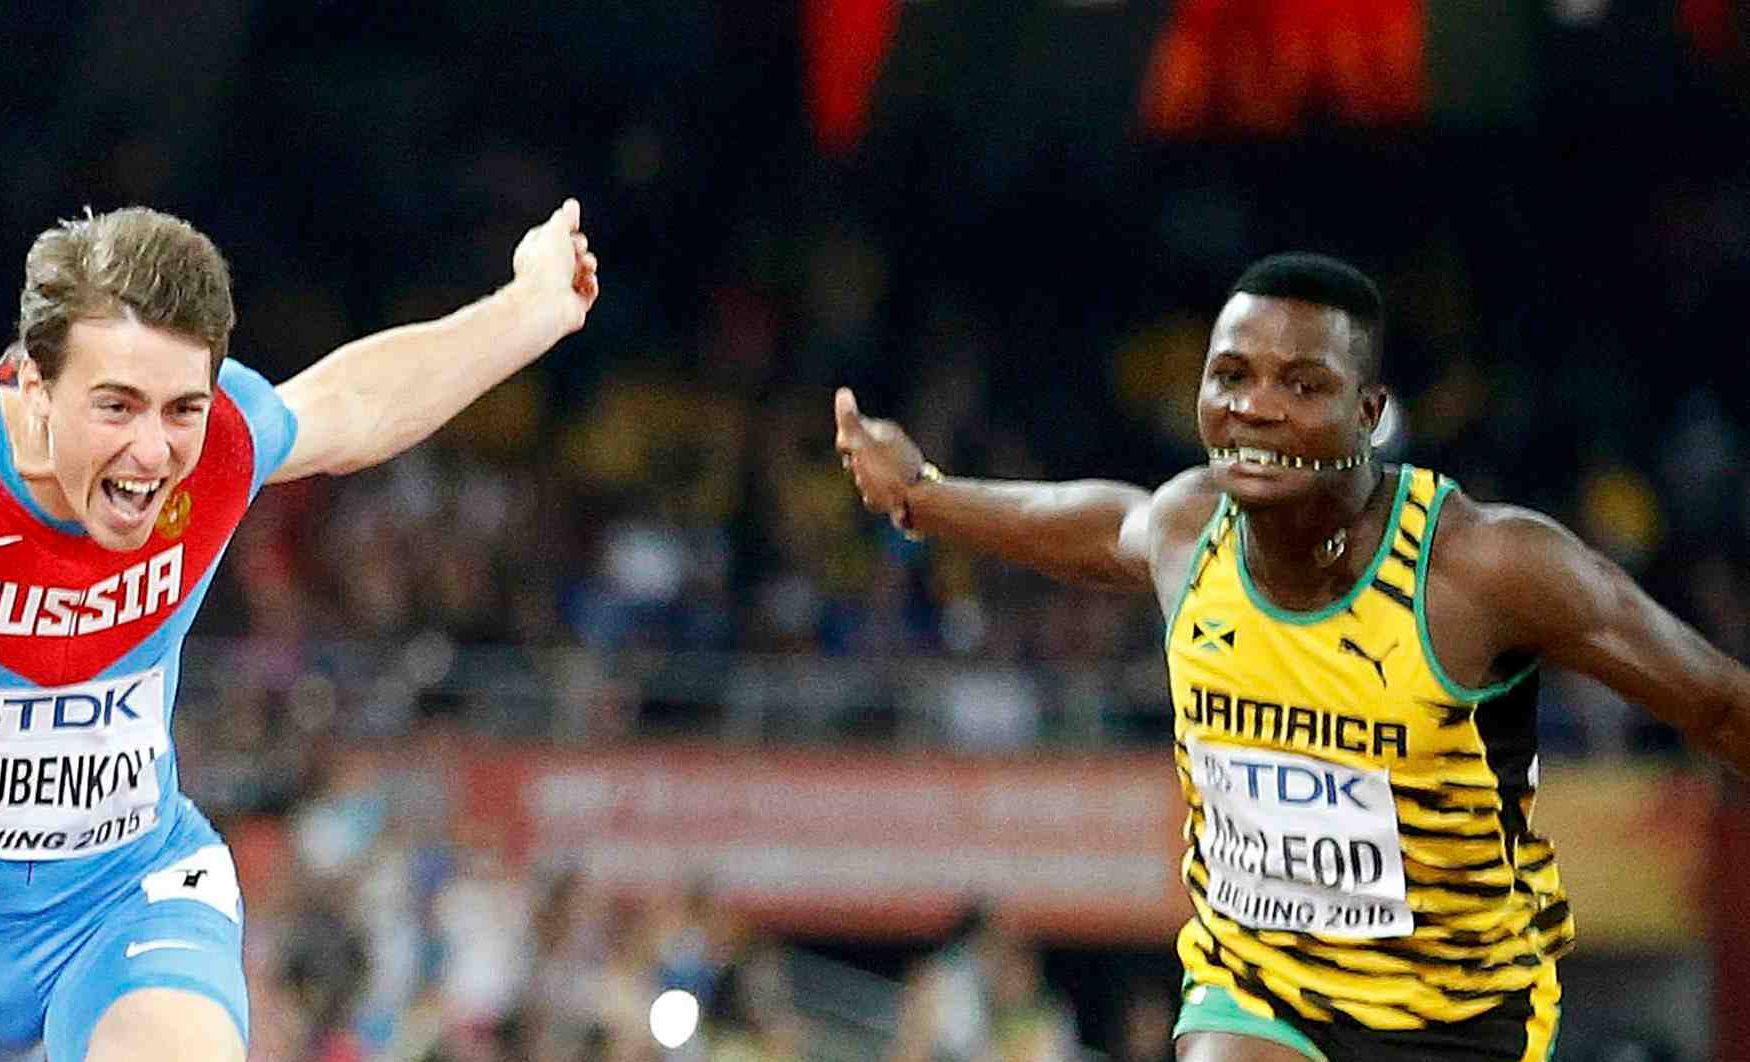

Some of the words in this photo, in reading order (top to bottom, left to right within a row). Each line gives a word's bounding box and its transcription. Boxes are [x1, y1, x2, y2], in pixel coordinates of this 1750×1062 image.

[4, 680, 143, 730] TDK
[1184, 687, 1407, 757] JAMAICA
[1230, 759, 1371, 809] TDK
[74, 808, 141, 848] 2015
[1217, 880, 1314, 924] BEIJING
[1325, 903, 1395, 926] 2015
